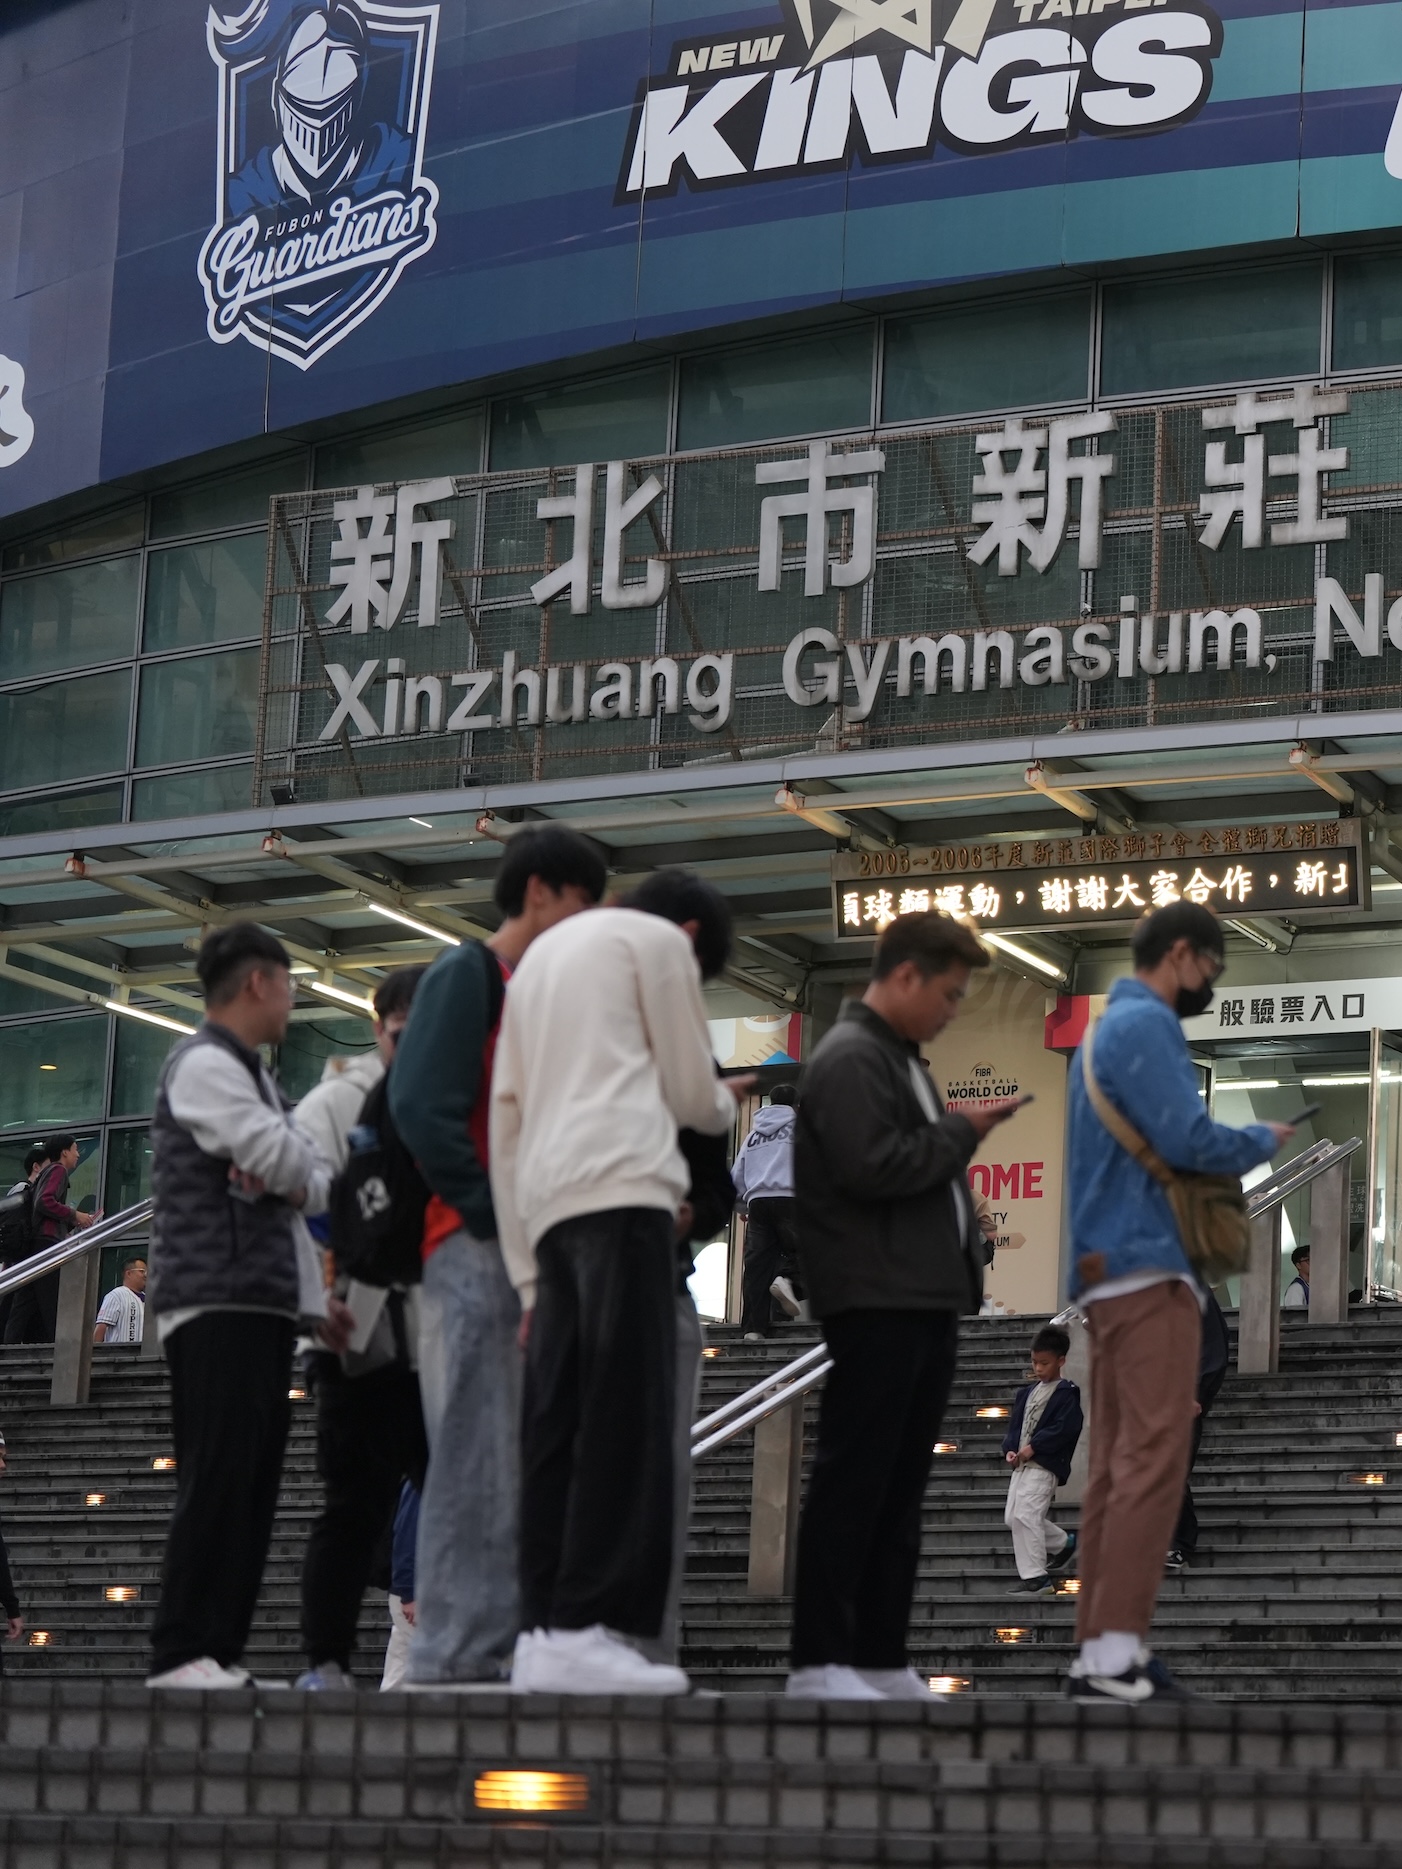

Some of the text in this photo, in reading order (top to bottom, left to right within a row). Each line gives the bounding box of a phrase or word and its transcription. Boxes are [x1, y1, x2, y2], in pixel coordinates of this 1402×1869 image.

[677, 34, 785, 76] NEW
[626, 12, 1211, 191] KINGS
[264, 209, 324, 241] FUBON
[210, 190, 424, 326] Guardians
[318, 649, 736, 742] Xinzhuang
[782, 595, 1278, 723] Gymnasium,
[948, 1078, 1018, 1087] BASKETBALL
[975, 1067, 991, 1077] FIBA
[947, 1085, 1018, 1099] WORLD CUP
